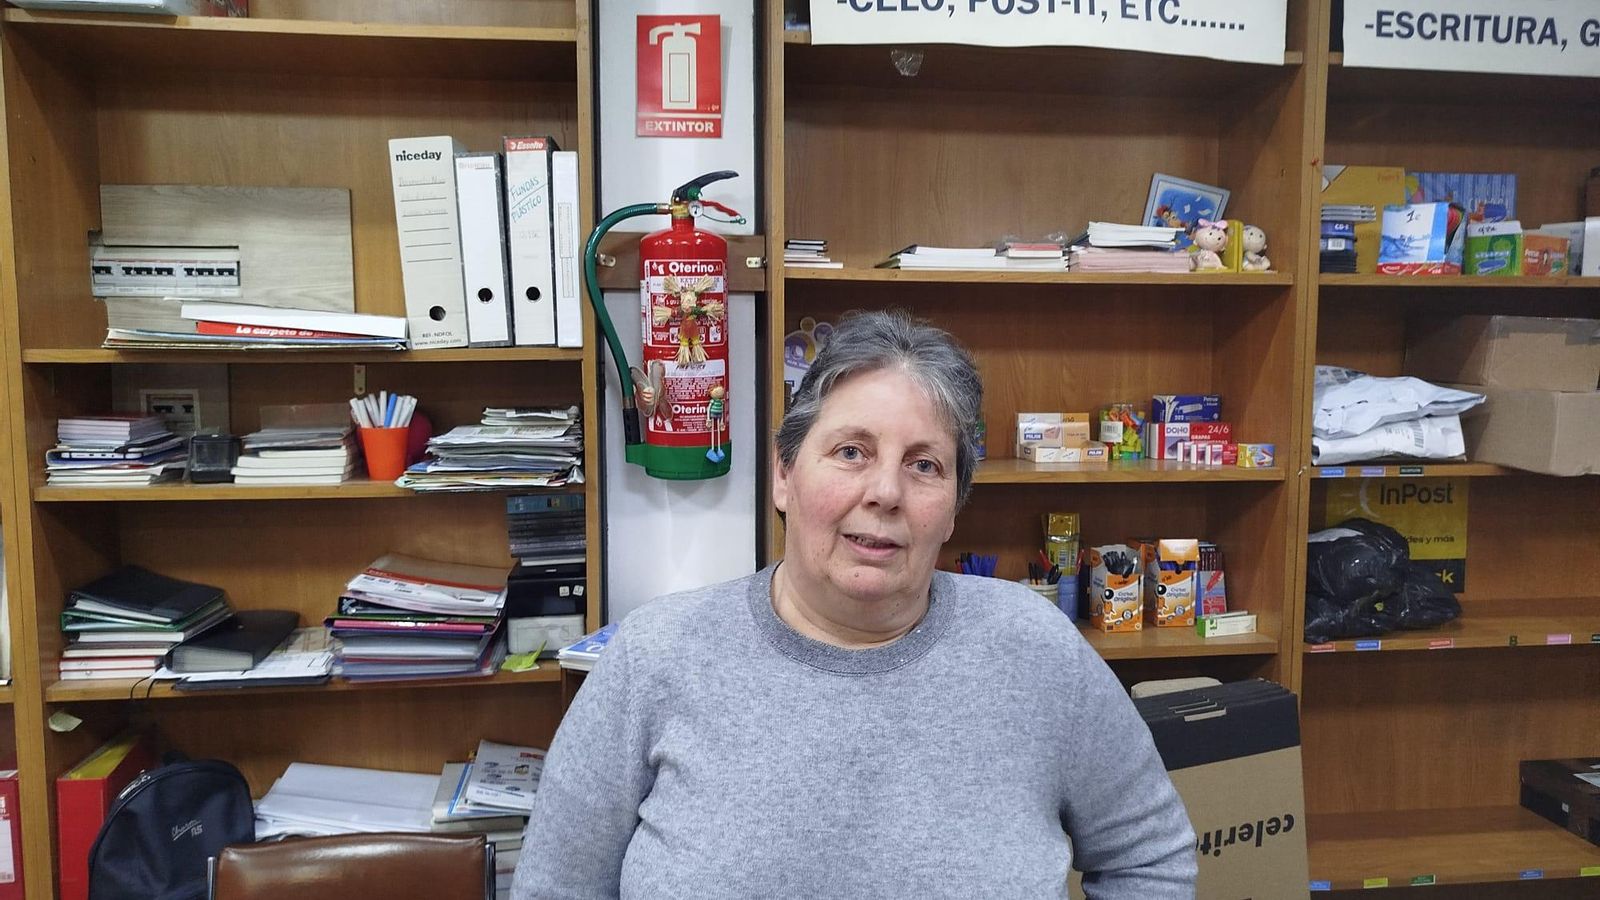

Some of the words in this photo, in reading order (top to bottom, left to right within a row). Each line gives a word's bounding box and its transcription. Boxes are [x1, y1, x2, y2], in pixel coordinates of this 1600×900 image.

[1365, 10, 1568, 51] -ESCRITURA,
[645, 120, 714, 133] EXTINTOR
[395, 150, 442, 162] niceday
[510, 176, 540, 201] FUNDAS
[668, 261, 714, 273] Oterino
[235, 326, 252, 334] La
[252, 328, 297, 336] carpeta
[672, 403, 707, 414] Oterin
[1208, 425, 1230, 434] 24/6
[1380, 483, 1454, 505] InPost
[1196, 814, 1294, 857] celerit
